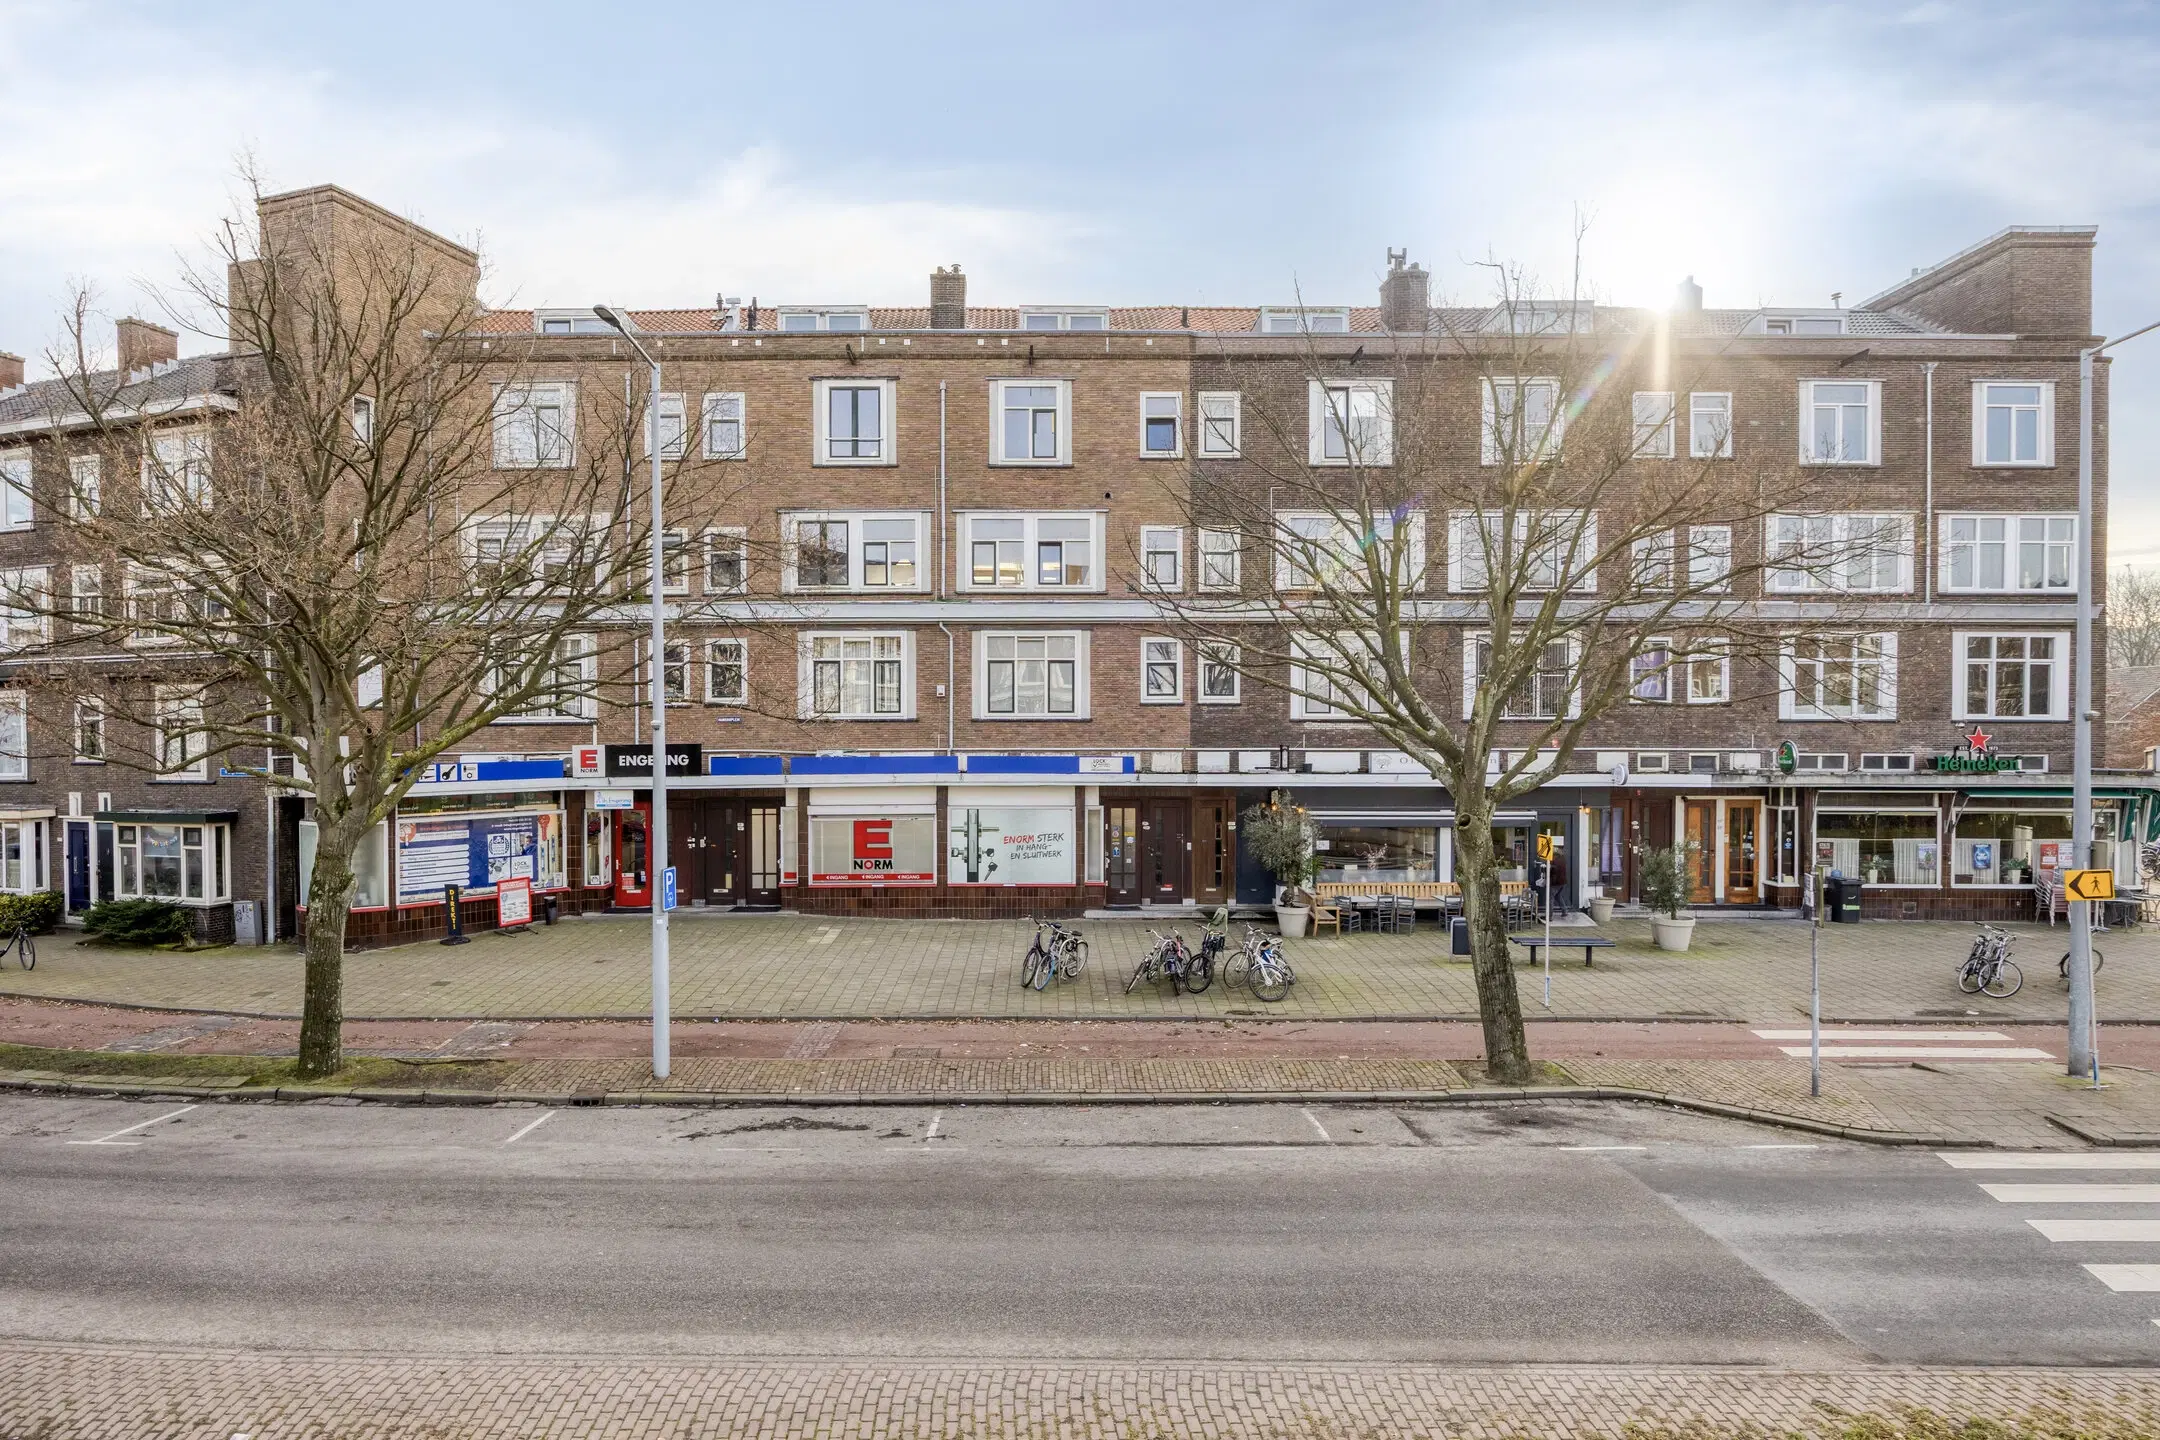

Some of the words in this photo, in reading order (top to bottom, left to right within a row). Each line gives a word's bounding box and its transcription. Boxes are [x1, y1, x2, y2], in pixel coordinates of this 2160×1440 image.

[619, 754, 690, 766] ENGENG
[1936, 755, 2020, 771] Heineken
[1003, 834, 1035, 844] ENORM
[1037, 832, 1065, 842] STERK
[1026, 843, 1053, 851] HANG-
[1010, 852, 1020, 860] EN
[1022, 850, 1063, 860] SLUITWERK
[853, 859, 893, 870] NORM
[666, 871, 673, 893] P
